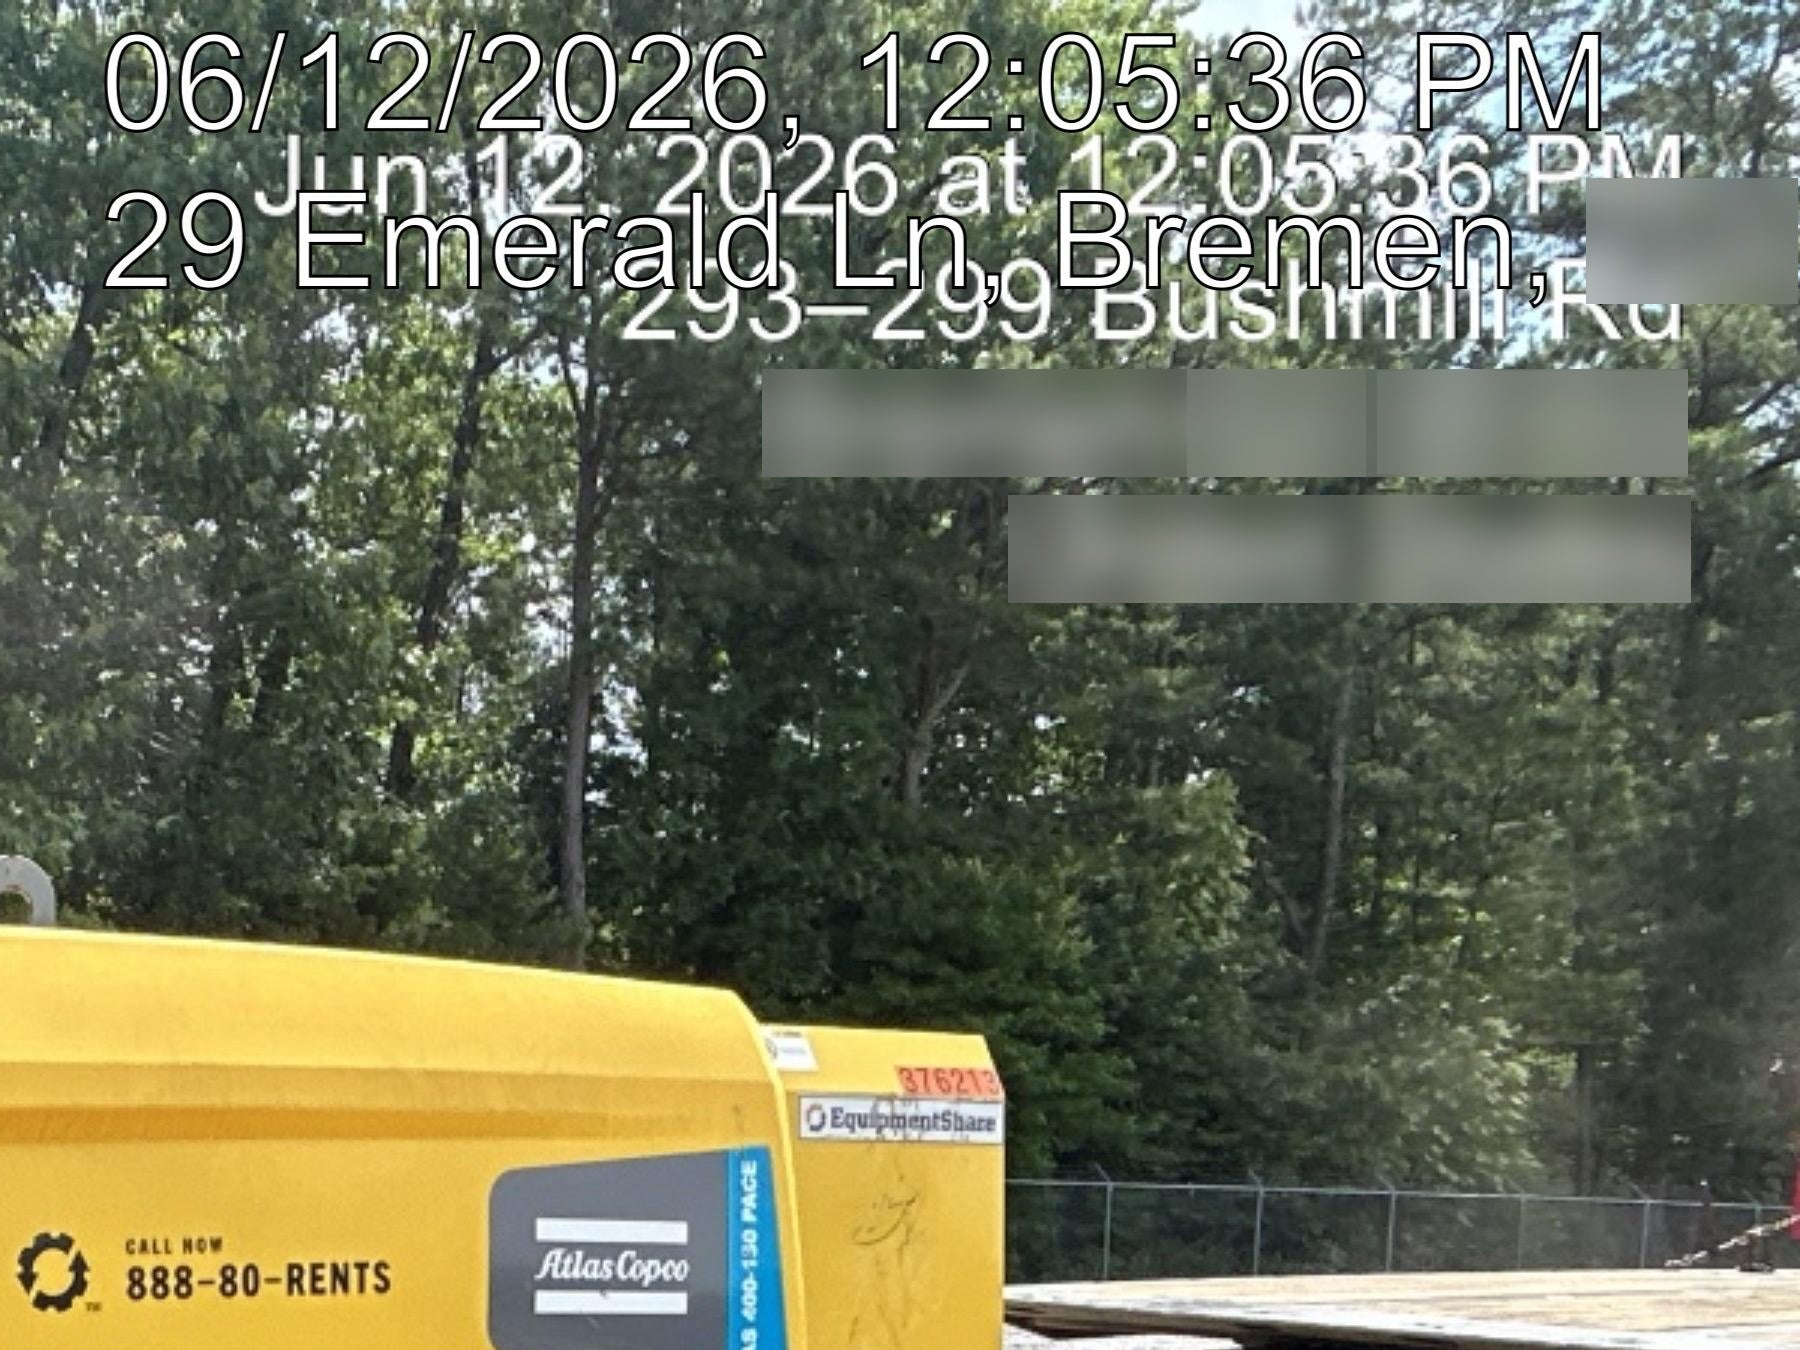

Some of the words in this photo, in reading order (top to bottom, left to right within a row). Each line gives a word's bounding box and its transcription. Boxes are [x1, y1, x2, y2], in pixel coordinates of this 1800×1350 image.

[899, 1067, 1000, 1096] 376213
[830, 1107, 996, 1135] EquipmentShare
[740, 1159, 759, 1223] PACE
[125, 1237, 172, 1255] CALL
[182, 1236, 223, 1255] NOW
[126, 1261, 391, 1301] 888-80-RENTS
[534, 1248, 614, 1280] Atlas
[616, 1250, 691, 1288] Copco
[740, 1229, 760, 1322] 400-130
